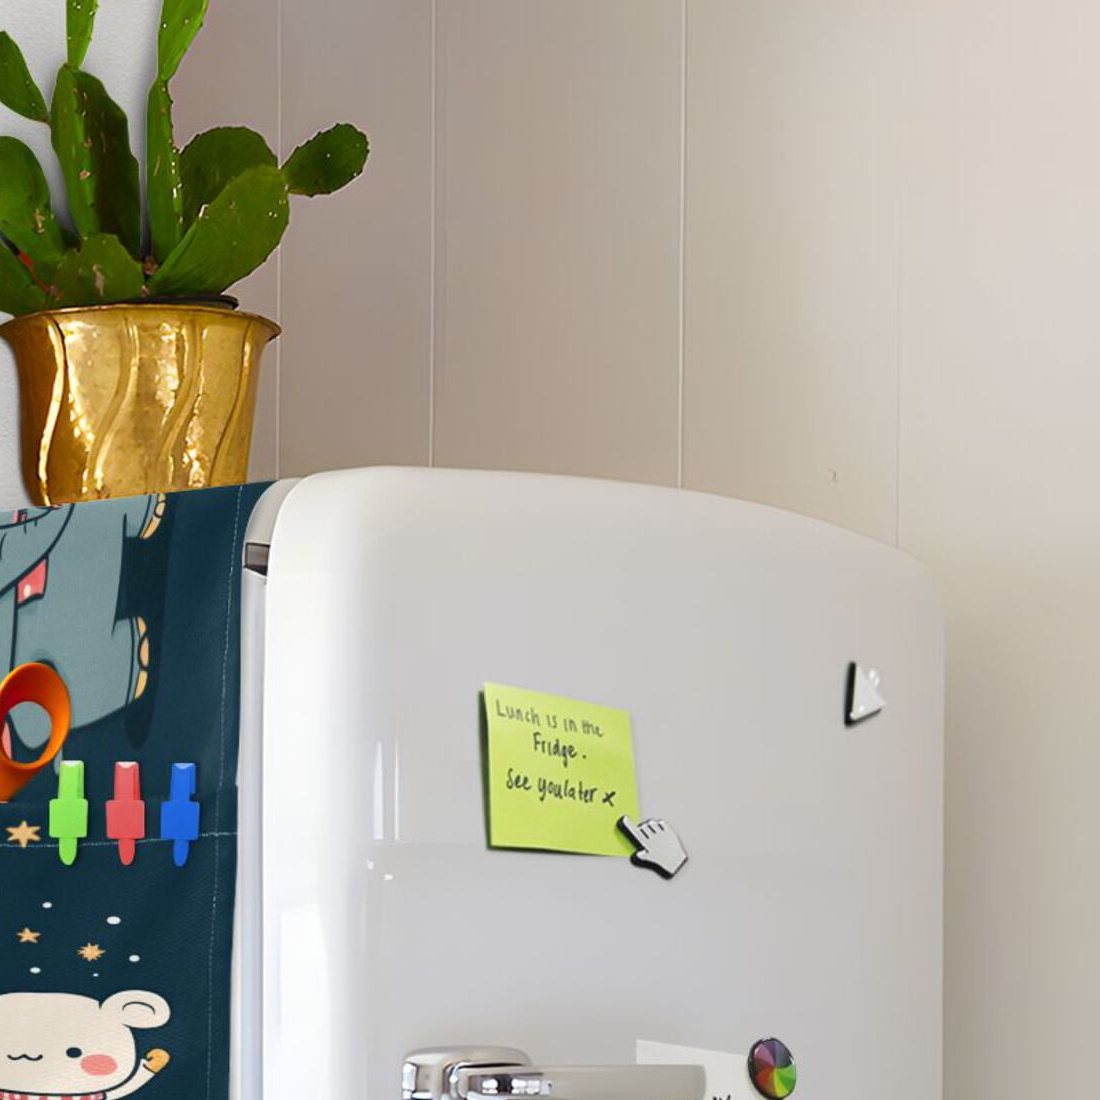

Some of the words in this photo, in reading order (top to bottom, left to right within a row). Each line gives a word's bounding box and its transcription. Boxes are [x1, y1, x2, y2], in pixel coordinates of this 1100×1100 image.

[495, 699, 540, 727] Lunch
[546, 714, 557, 729] is
[563, 717, 578, 733] in
[582, 720, 604, 738] the
[506, 768, 532, 791] See
